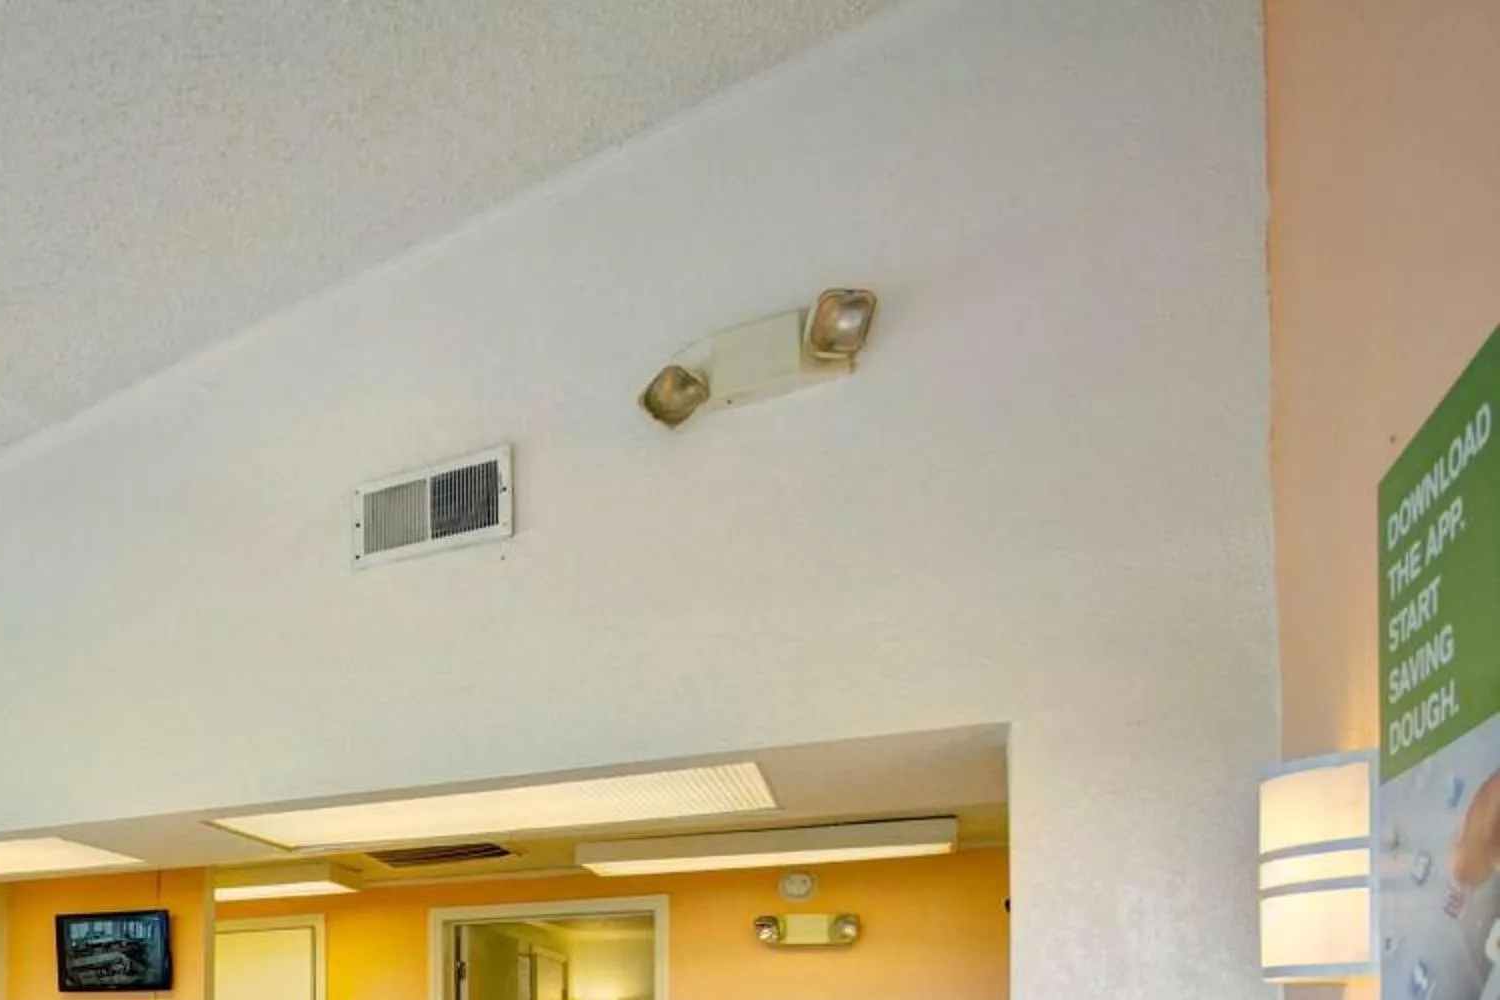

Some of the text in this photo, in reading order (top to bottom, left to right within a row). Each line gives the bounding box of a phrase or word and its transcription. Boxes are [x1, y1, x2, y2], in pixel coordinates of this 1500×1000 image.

[1387, 402, 1491, 551] DOWNLOAD
[1388, 496, 1466, 601] THE APP.
[1388, 576, 1441, 652] START
[1388, 623, 1455, 704] SAVING
[1389, 679, 1459, 756] DOUGH.
